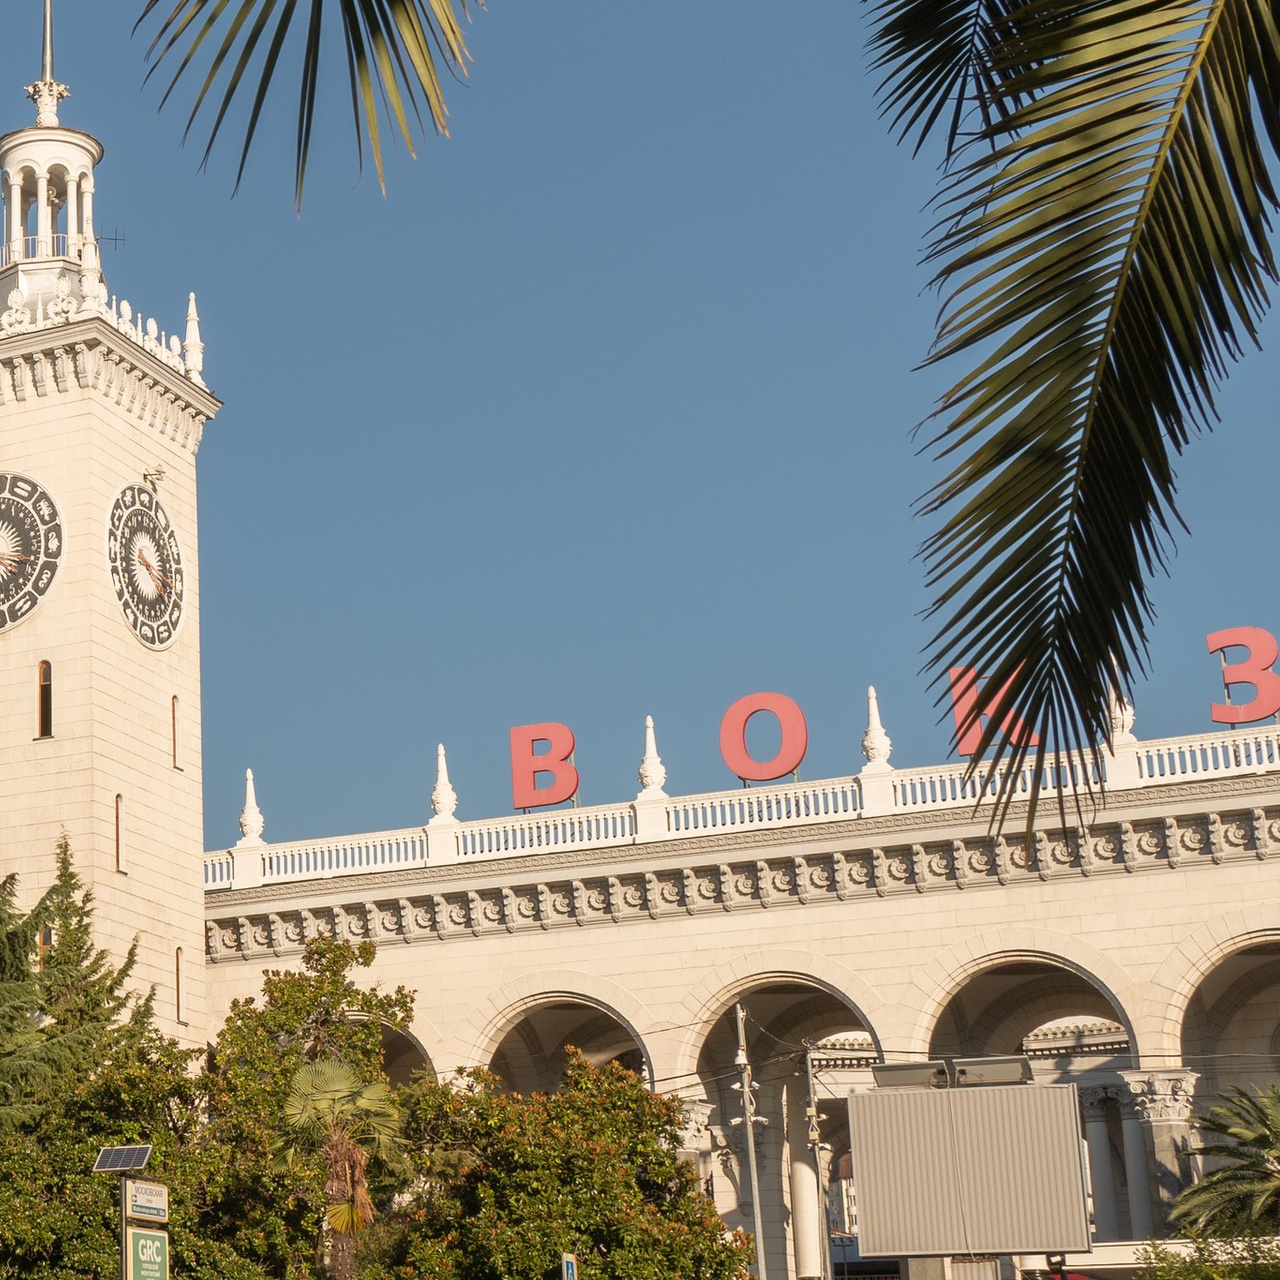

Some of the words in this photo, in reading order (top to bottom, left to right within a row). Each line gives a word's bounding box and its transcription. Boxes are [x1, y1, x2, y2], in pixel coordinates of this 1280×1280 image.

[24, 517, 31, 529] 2
[31, 539, 37, 550] 3
[9, 583, 16, 595] 5
[138, 1239, 161, 1263] GRC
